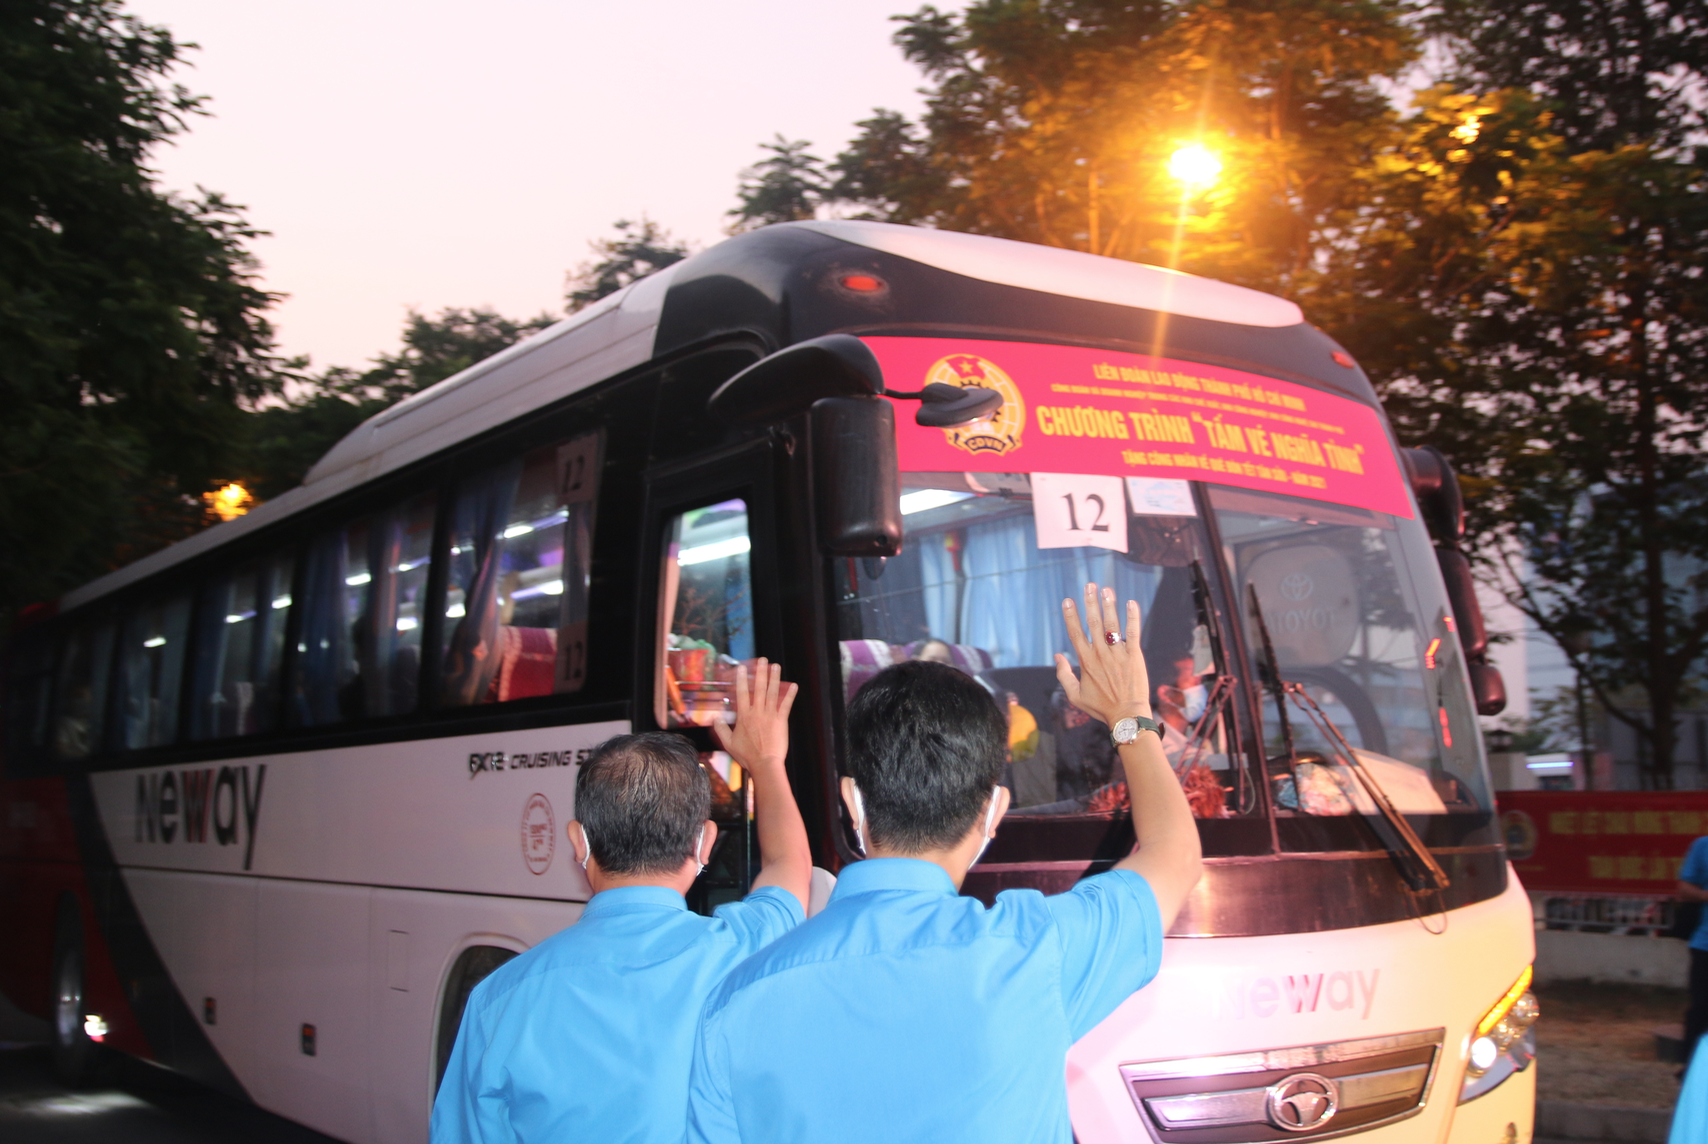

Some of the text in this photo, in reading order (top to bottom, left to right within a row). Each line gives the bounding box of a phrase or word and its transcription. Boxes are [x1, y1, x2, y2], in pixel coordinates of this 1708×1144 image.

[1035, 405, 1130, 440] CHƯƠNG
[1128, 408, 1195, 444] TRÌNH
[1270, 433, 1327, 467] NGHĨA
[561, 454, 585, 494] 12
[1061, 491, 1111, 533] 12
[510, 751, 572, 769] CRUISING
[135, 763, 267, 871] Neway
[1211, 967, 1382, 1021] Neway
